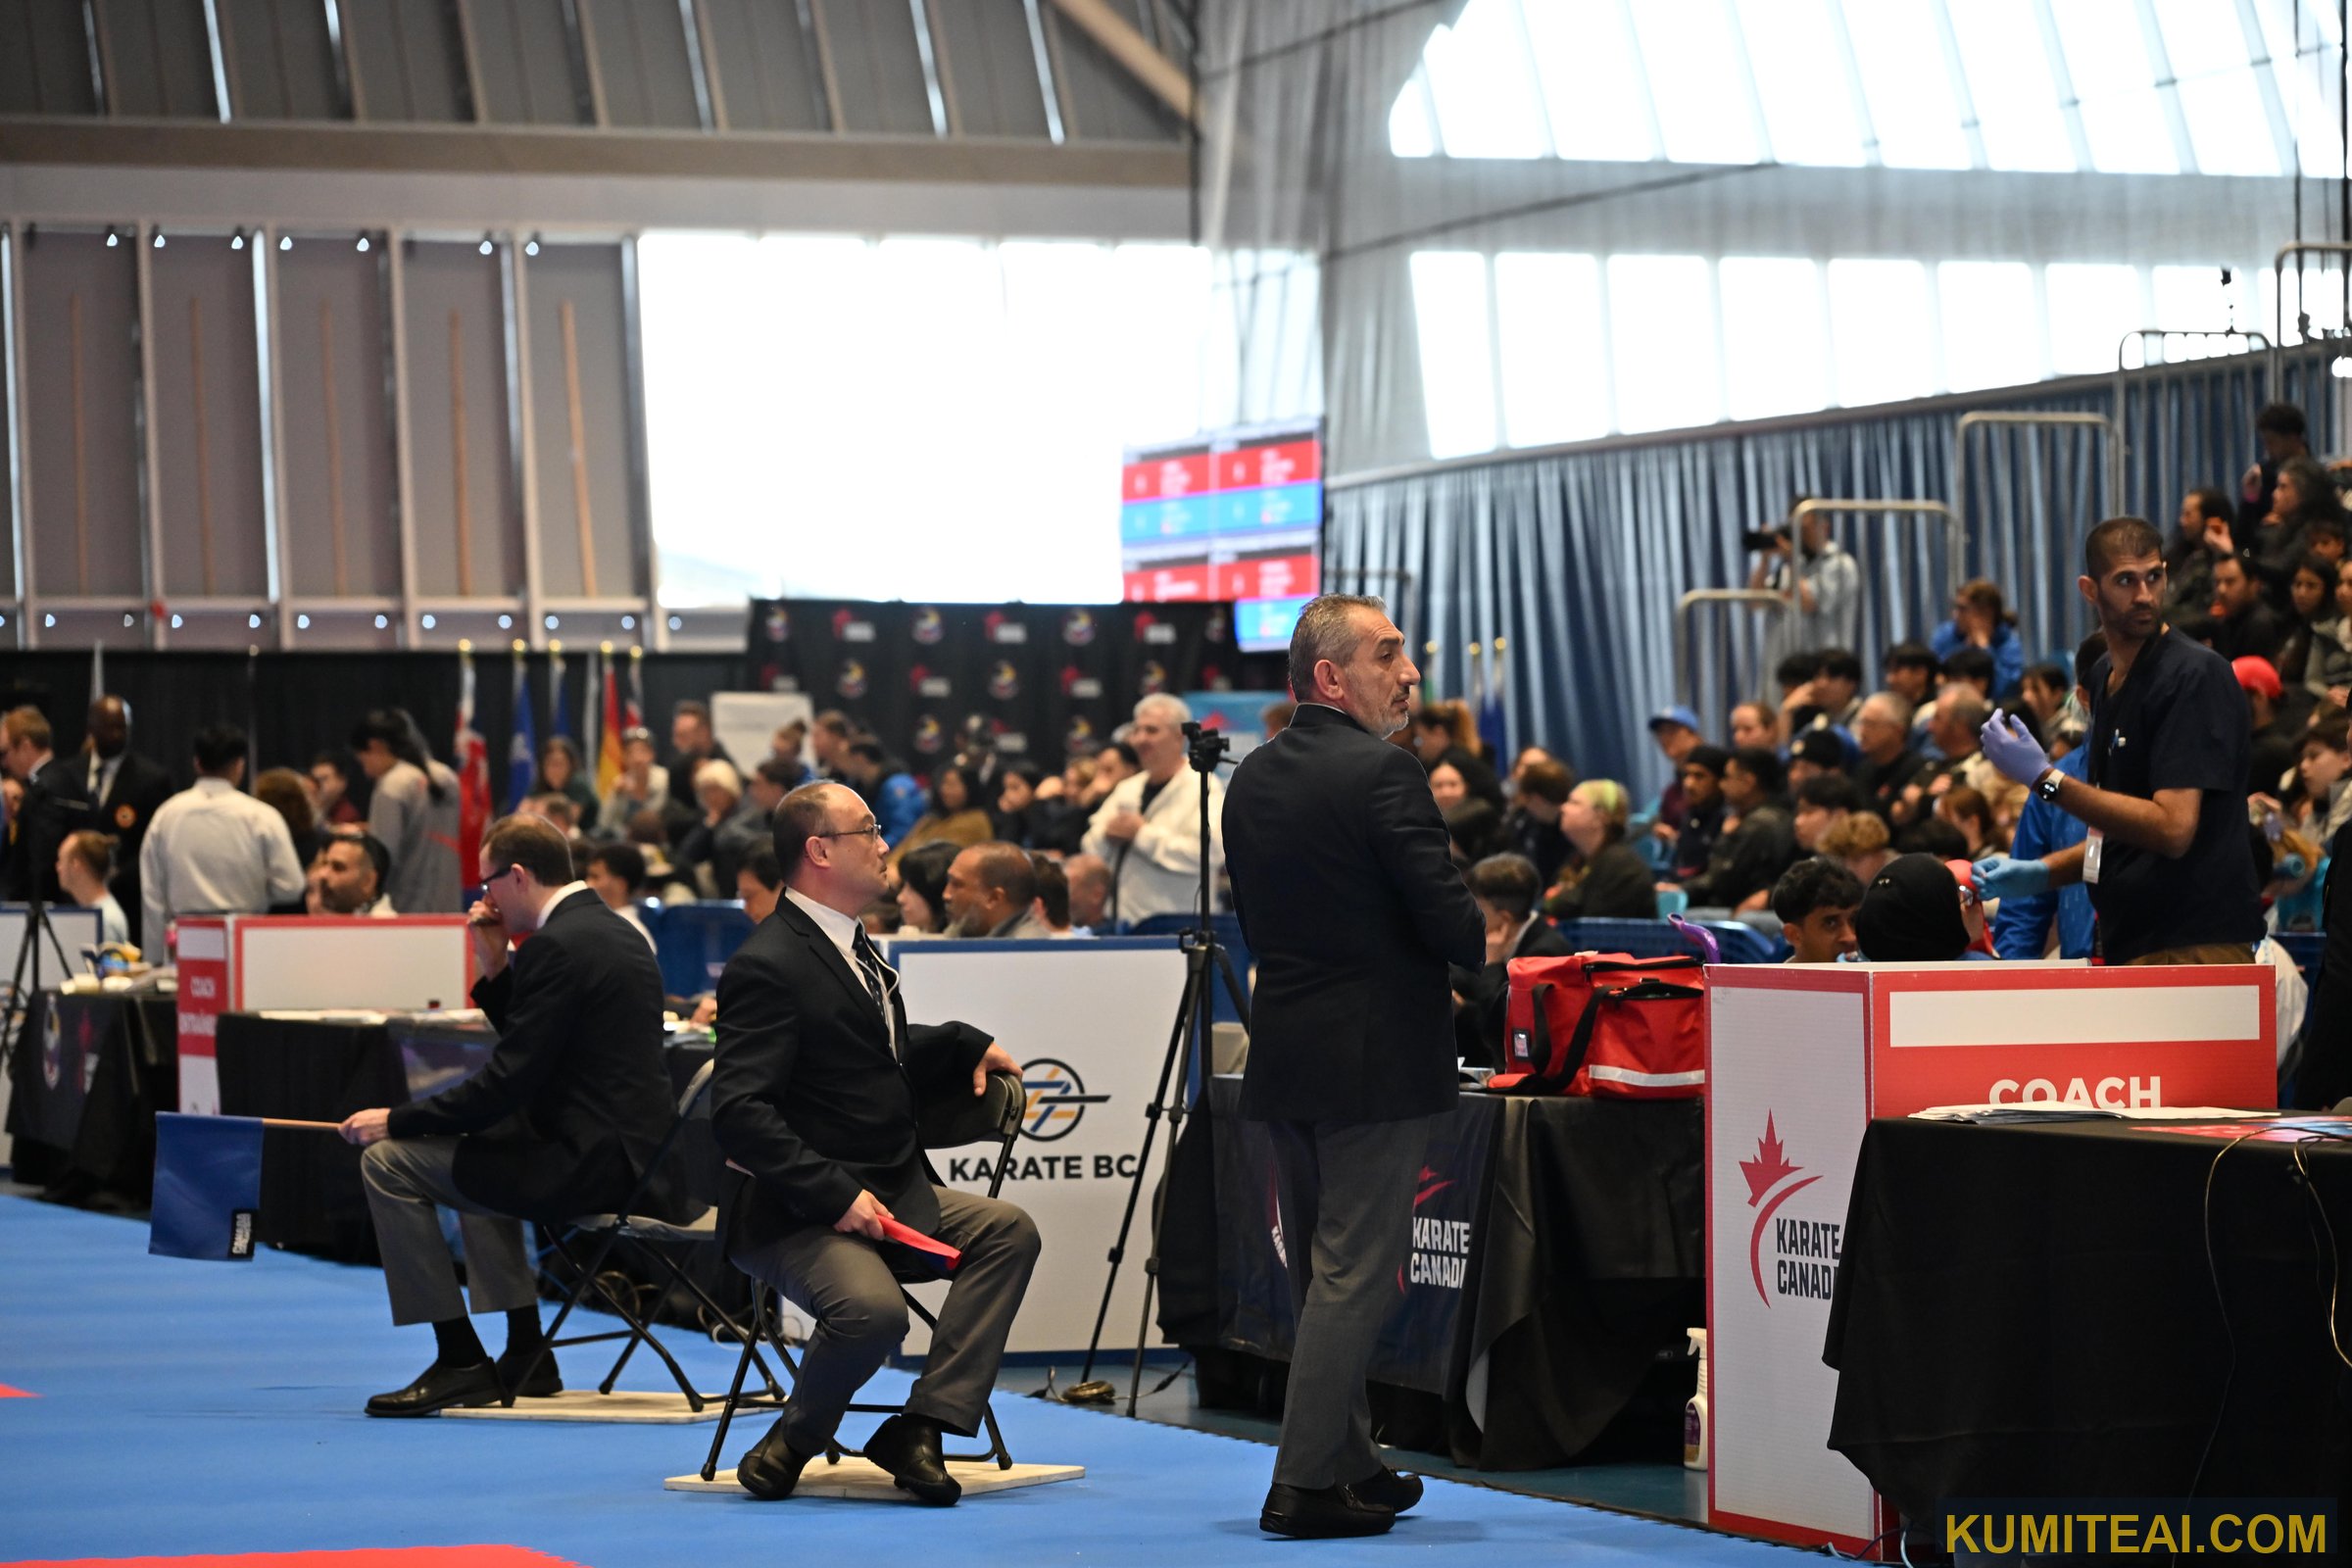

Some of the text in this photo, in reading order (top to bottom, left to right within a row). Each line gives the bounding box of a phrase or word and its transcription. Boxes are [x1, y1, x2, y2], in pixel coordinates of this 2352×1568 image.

[1988, 1075, 2161, 1109] COACH
[949, 1153, 1138, 1182] KARATE BC
[1412, 1216, 1470, 1254] KARATE
[1776, 1217, 1841, 1260] KARATE
[1777, 1258, 1838, 1300] CANAD
